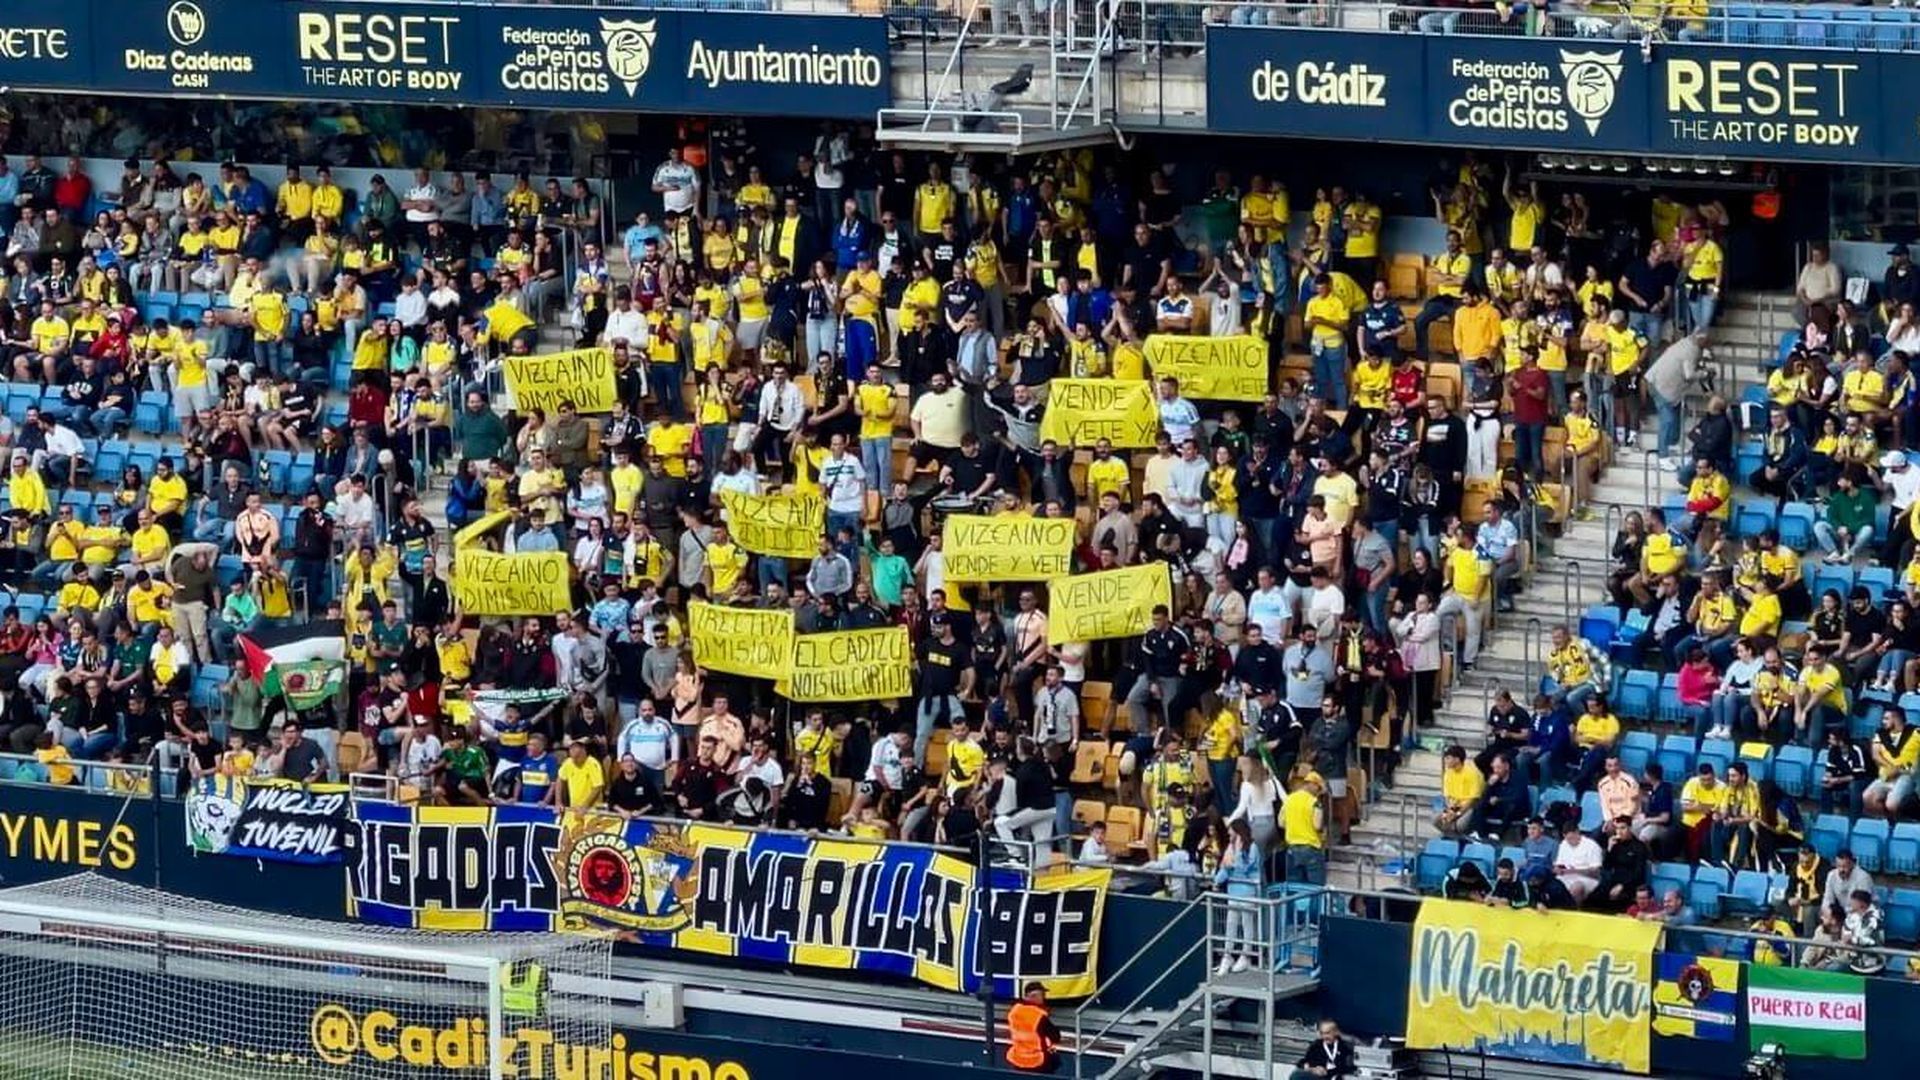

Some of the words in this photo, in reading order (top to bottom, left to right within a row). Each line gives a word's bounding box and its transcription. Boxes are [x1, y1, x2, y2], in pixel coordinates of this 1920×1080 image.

[299, 12, 460, 65] RESET
[502, 26, 591, 47] Federación
[170, 50, 253, 71] Cadenas
[687, 40, 881, 88] Ayuntamiento
[1452, 58, 1550, 81] Federación
[172, 74, 209, 88] CASH
[302, 67, 336, 86] THE
[338, 68, 375, 87] ART
[376, 70, 403, 88] OF
[407, 71, 462, 91] BODY
[501, 64, 609, 93] Cadistas
[1252, 60, 1290, 102] de
[1296, 60, 1386, 107] Cádiz
[1667, 59, 1859, 117] RESET
[1448, 100, 1569, 132] Cadistas
[1669, 119, 1709, 141] THE
[1712, 121, 1756, 142] ART
[1758, 123, 1789, 143] OF
[1794, 124, 1860, 146] BODY
[508, 350, 606, 385] VIZCAINO
[1051, 384, 1129, 411] VENDE
[1064, 420, 1126, 442] VETE
[944, 554, 999, 577] VENDE
[1010, 556, 1022, 573] Y
[1030, 554, 1070, 575] VETE
[1056, 574, 1132, 610] VENDE
[1150, 573, 1162, 599] Y
[1064, 610, 1113, 639] VETE
[1124, 605, 1146, 634] YA
[795, 640, 822, 668] EL
[239, 818, 340, 857] JUVENIL
[694, 843, 970, 968] AMARILLAS
